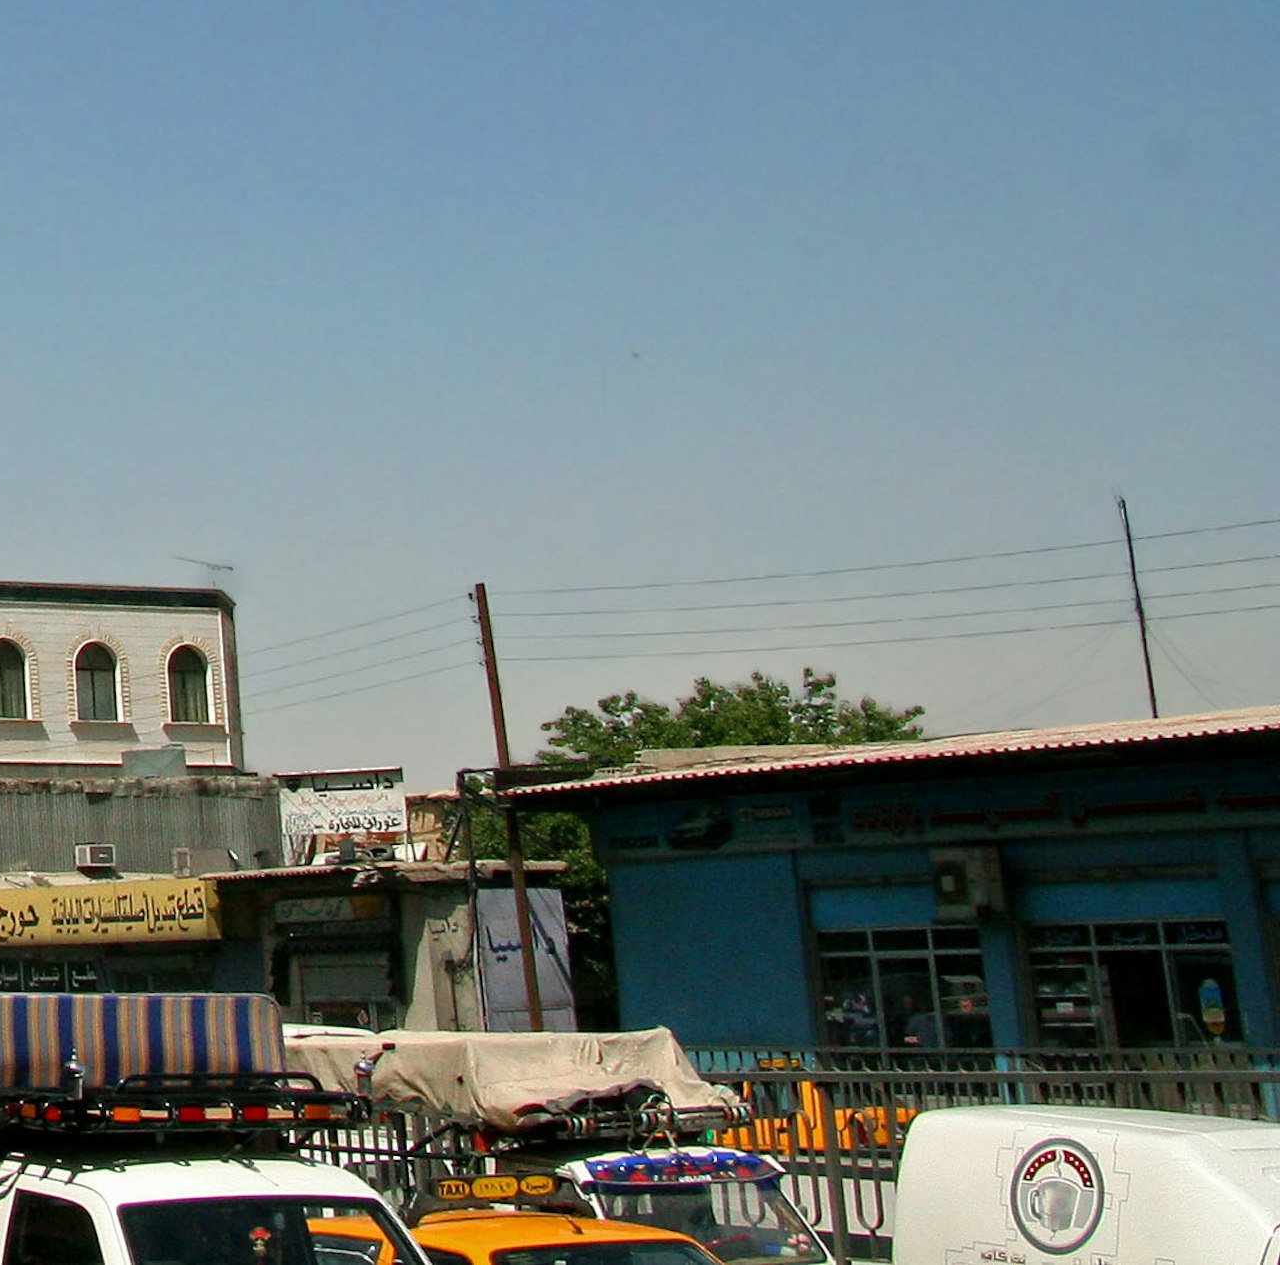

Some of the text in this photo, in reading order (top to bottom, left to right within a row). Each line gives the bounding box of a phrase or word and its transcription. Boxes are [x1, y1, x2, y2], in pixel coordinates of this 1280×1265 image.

[147, 895, 177, 934] تبديل
[177, 887, 205, 932] قطع
[440, 1183, 466, 1197] TAXI
